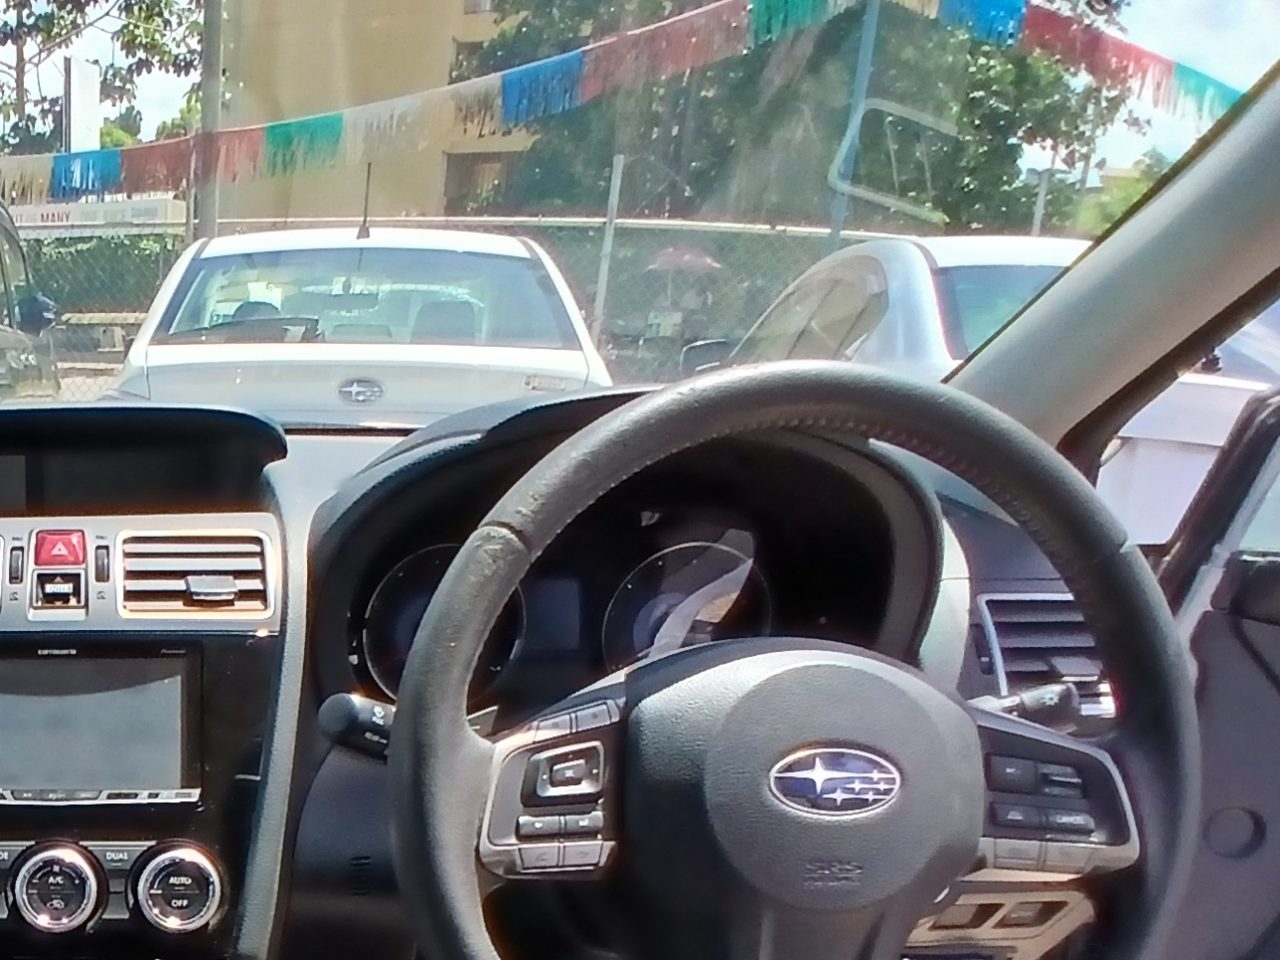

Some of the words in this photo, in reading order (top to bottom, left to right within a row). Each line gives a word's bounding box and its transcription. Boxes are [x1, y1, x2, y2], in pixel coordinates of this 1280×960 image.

[40, 212, 70, 223] MANY
[106, 851, 129, 860] DUAL
[48, 876, 64, 884] A/C
[168, 876, 192, 885] AUTO
[171, 899, 189, 908] OFF
